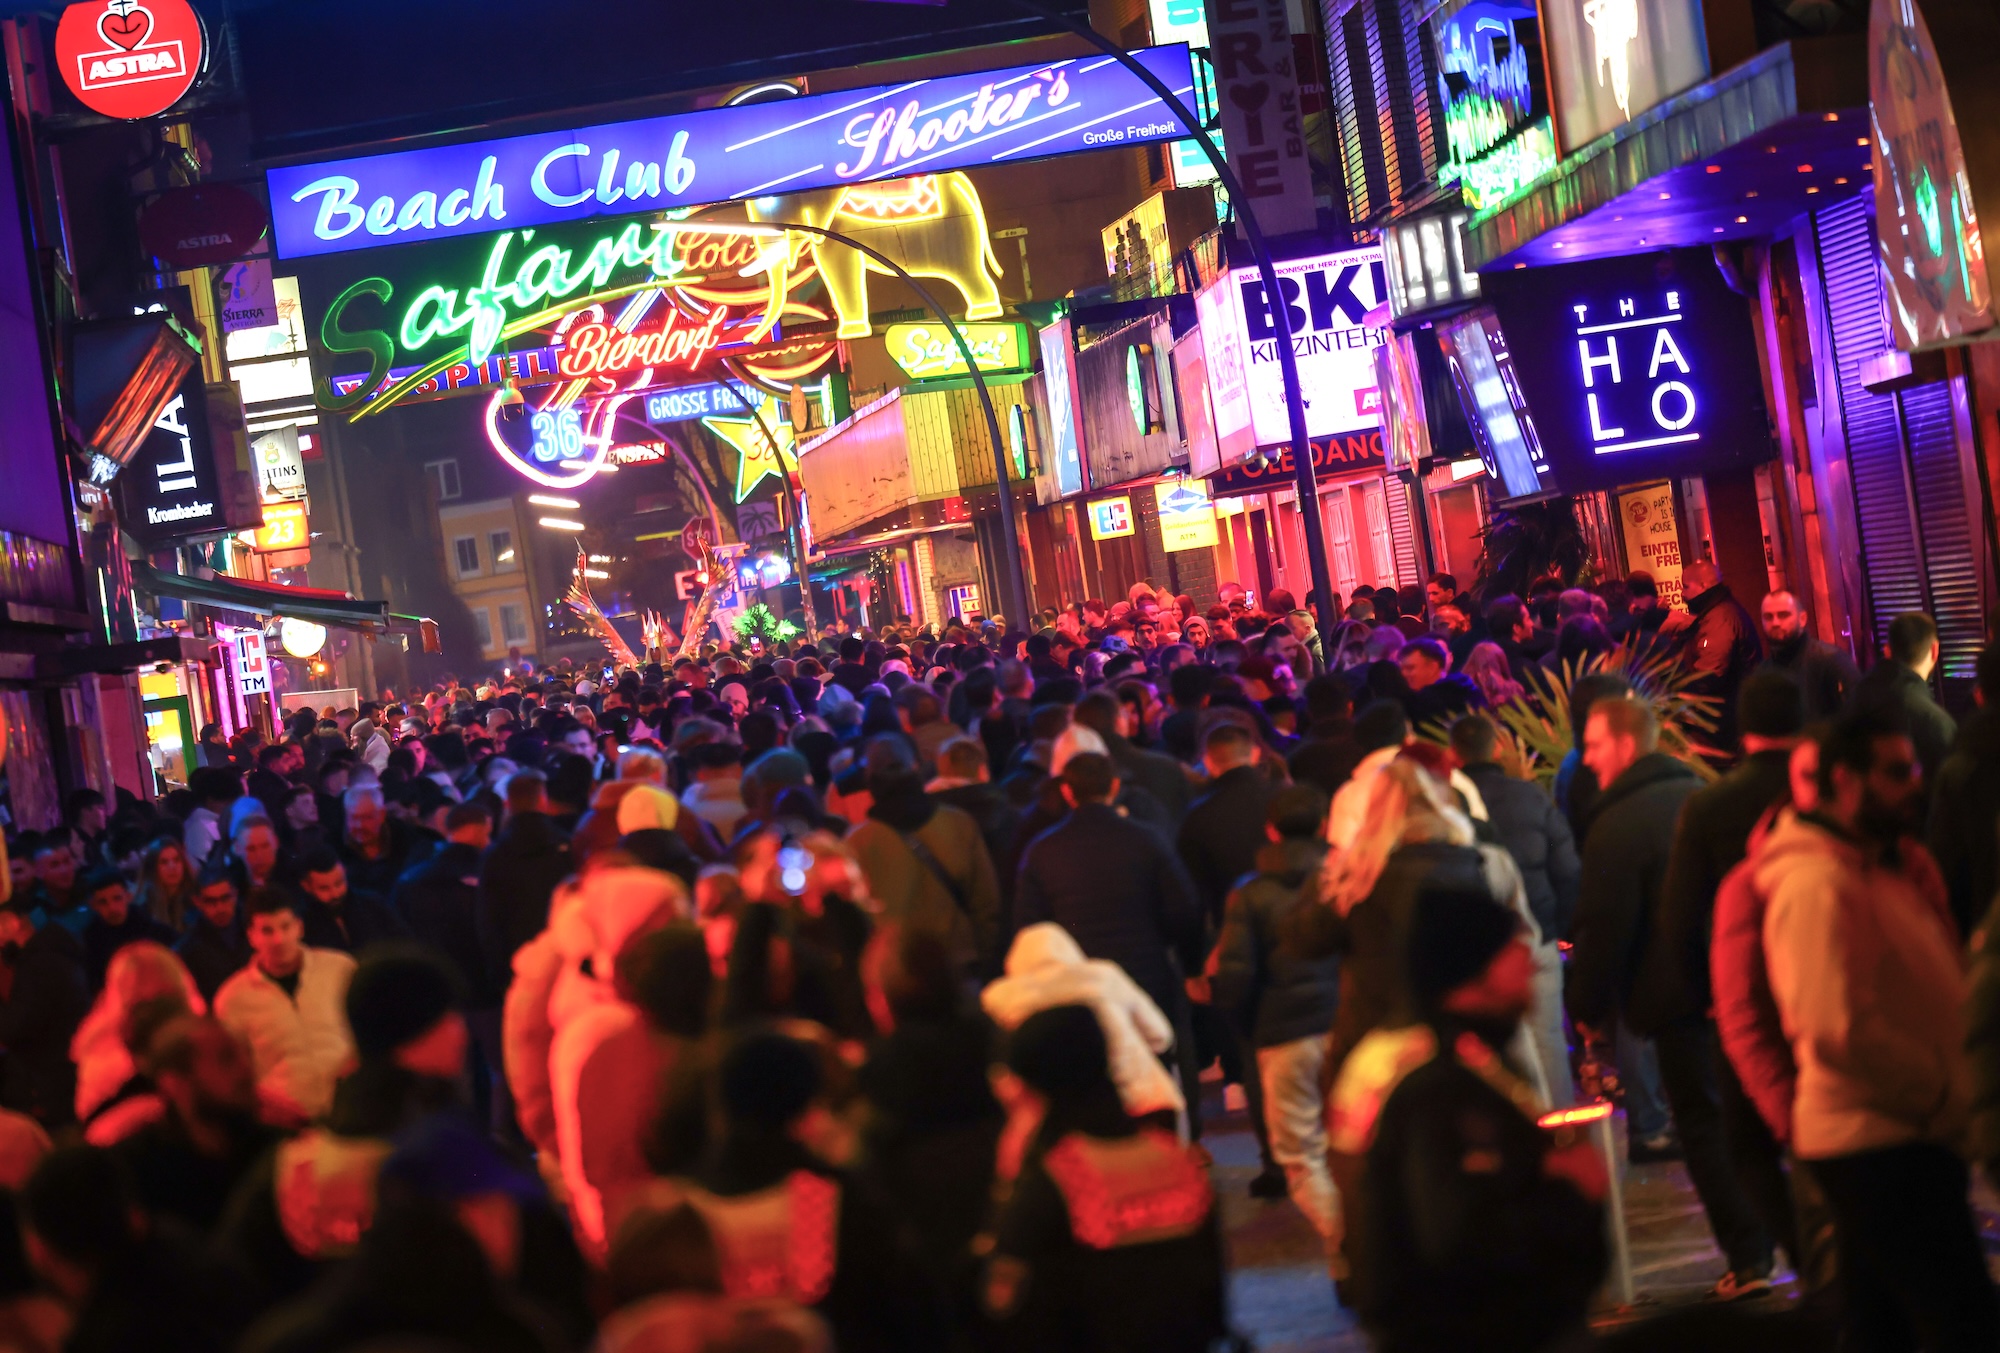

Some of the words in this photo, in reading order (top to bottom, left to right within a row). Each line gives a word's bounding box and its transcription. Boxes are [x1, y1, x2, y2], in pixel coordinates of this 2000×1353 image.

[89, 51, 177, 80] ASTRA
[835, 69, 1070, 177] Shooter's
[1083, 129, 1124, 145] Große
[1127, 121, 1176, 139] Freiheit
[291, 155, 507, 241] Beach
[530, 129, 696, 208] Club
[177, 233, 233, 250] ASTRA
[1239, 273, 1254, 282] DAS
[1318, 259, 1337, 268] HERZ
[1340, 256, 1359, 265] VON
[222, 307, 264, 323] SIERRA
[1573, 291, 1681, 323] THE
[560, 305, 728, 377] Bierdorf
[649, 391, 709, 420] GROSSE
[532, 409, 583, 463] 36
[148, 501, 214, 525] Krombacher
[1164, 518, 1211, 532] Geldautomat
[267, 520, 295, 545] 23
[1180, 532, 1197, 541] ATM
[1650, 520, 1672, 534] HOUSE
[1641, 541, 1679, 557] EINTR
[1656, 553, 1681, 568] FRE
